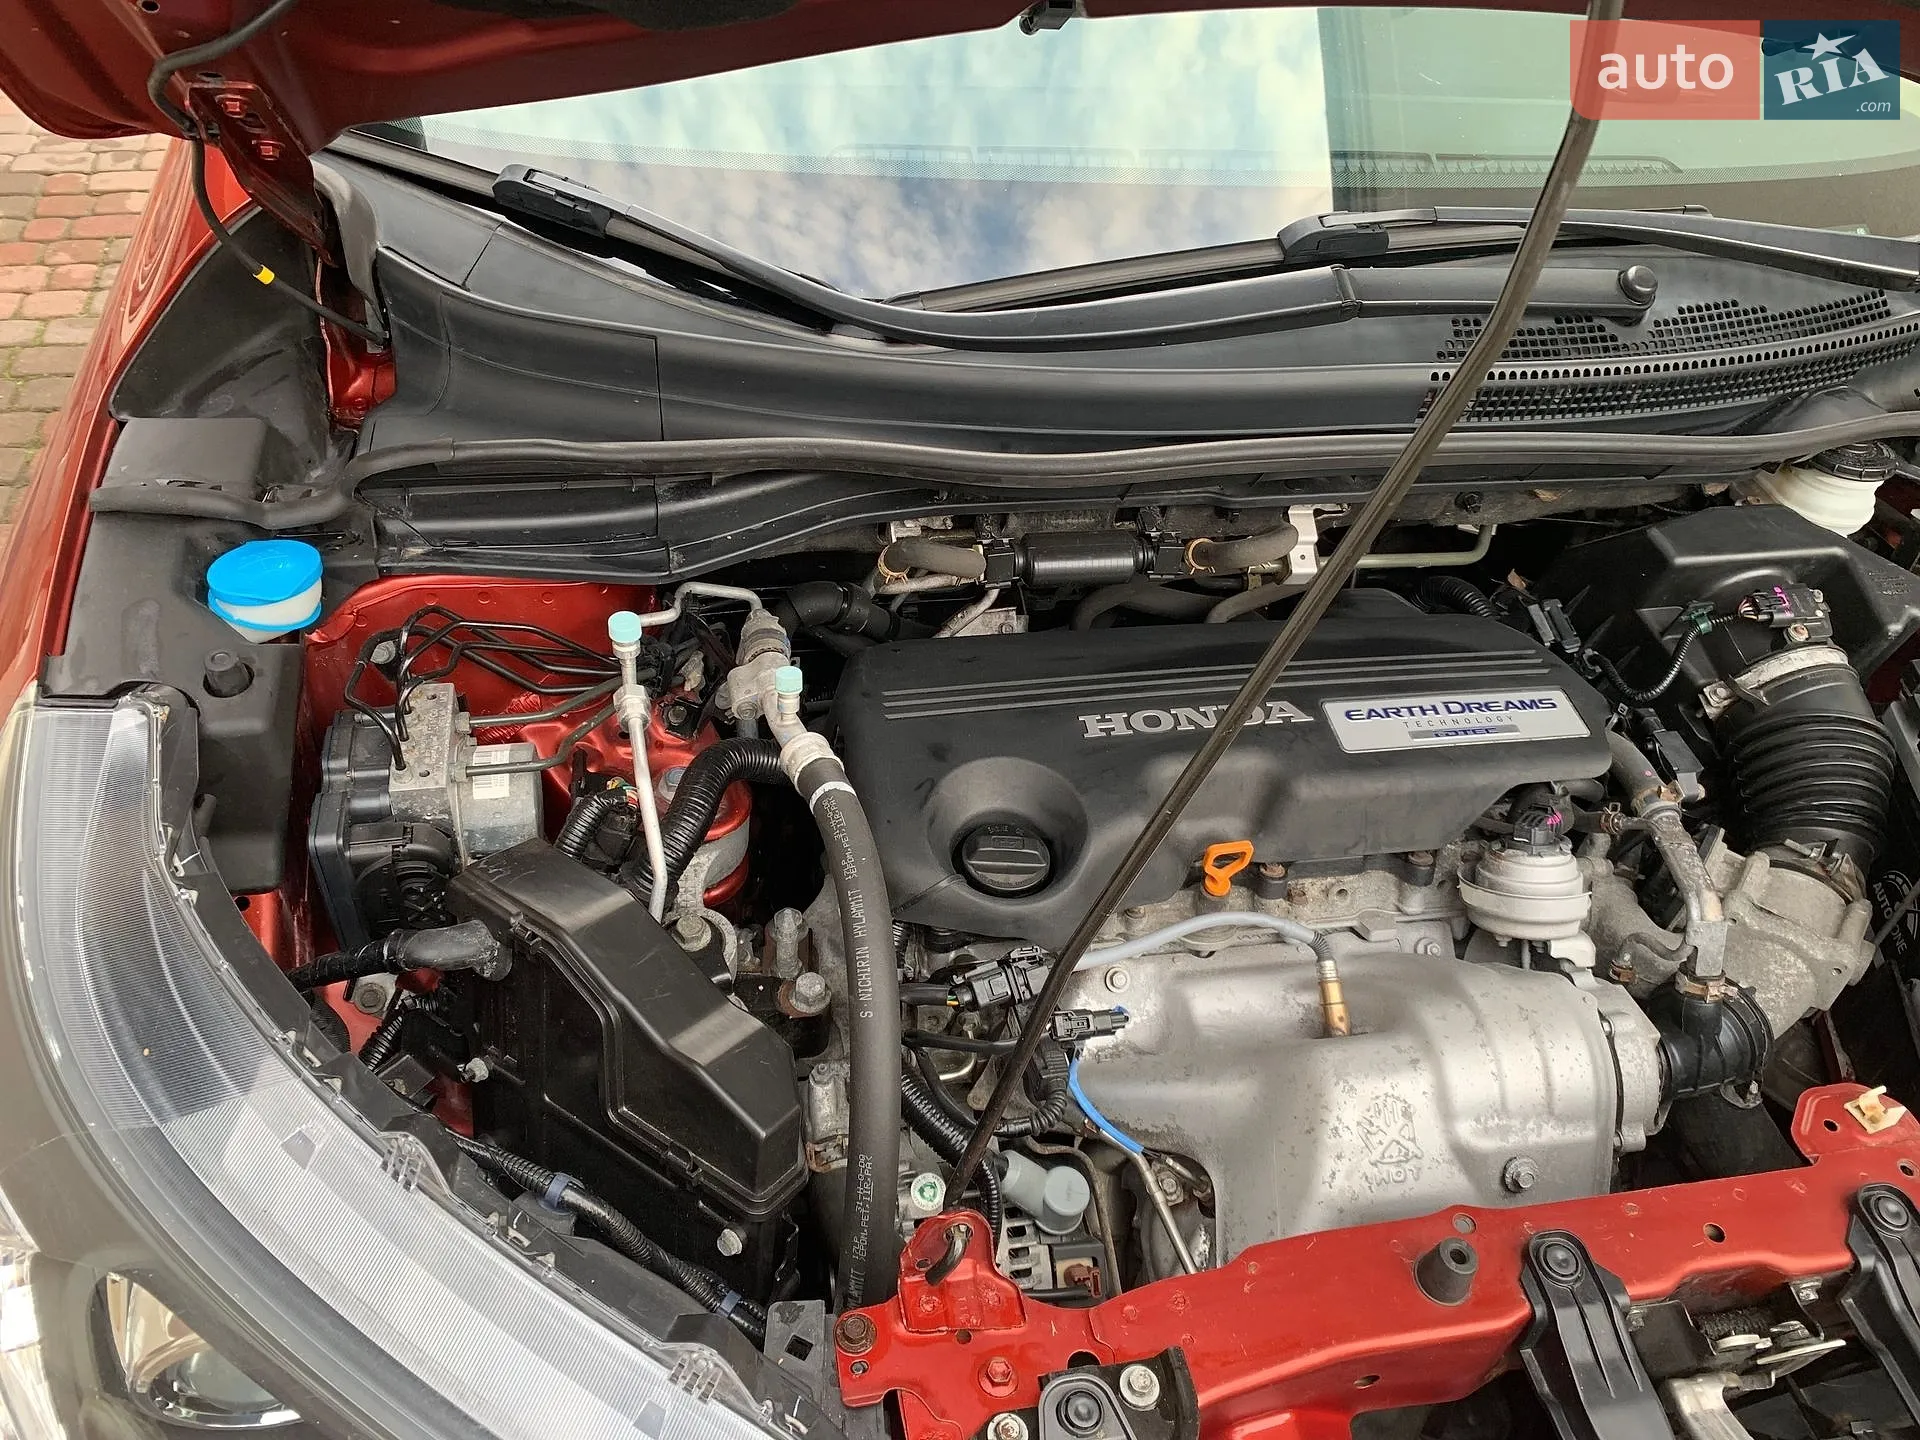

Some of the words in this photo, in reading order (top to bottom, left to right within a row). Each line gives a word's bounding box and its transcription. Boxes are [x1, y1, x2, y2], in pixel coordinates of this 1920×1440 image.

[1345, 702, 1440, 721] EARTH
[1446, 698, 1558, 715] DREAMS
[1402, 715, 1515, 729] TECHNOLOGY
[1873, 882, 1893, 919] AUTO
[855, 946, 873, 1001] NICHIRIN
